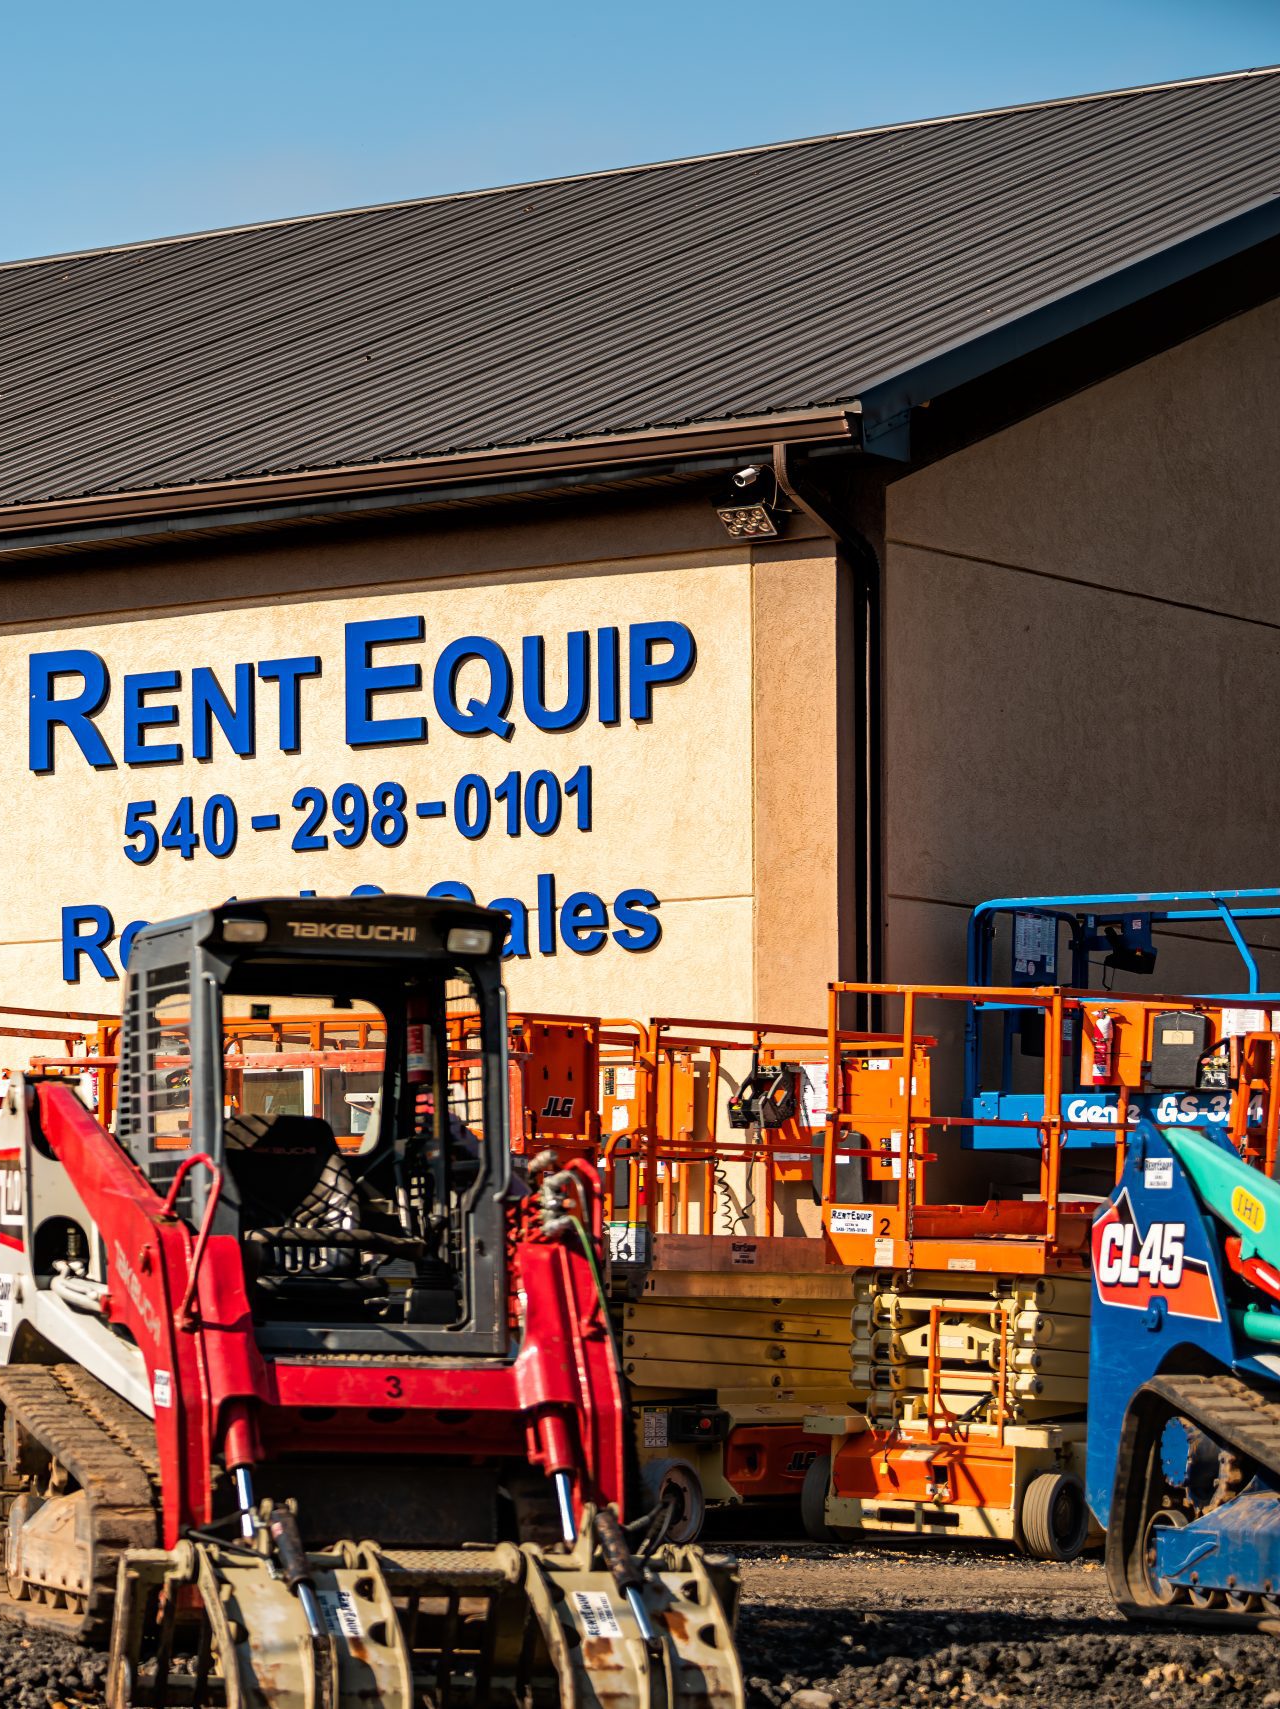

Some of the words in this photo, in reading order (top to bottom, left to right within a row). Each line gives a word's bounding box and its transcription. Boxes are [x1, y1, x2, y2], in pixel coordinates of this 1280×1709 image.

[28, 649, 322, 774] RENT
[345, 615, 697, 747] EQUIP
[541, 1096, 575, 1118] JLG
[1068, 1099, 1141, 1124] Gene
[1237, 1193, 1260, 1226] IHI
[880, 1218, 891, 1236] 2
[1099, 1223, 1186, 1287] CL45
[385, 1375, 403, 1399] 3
